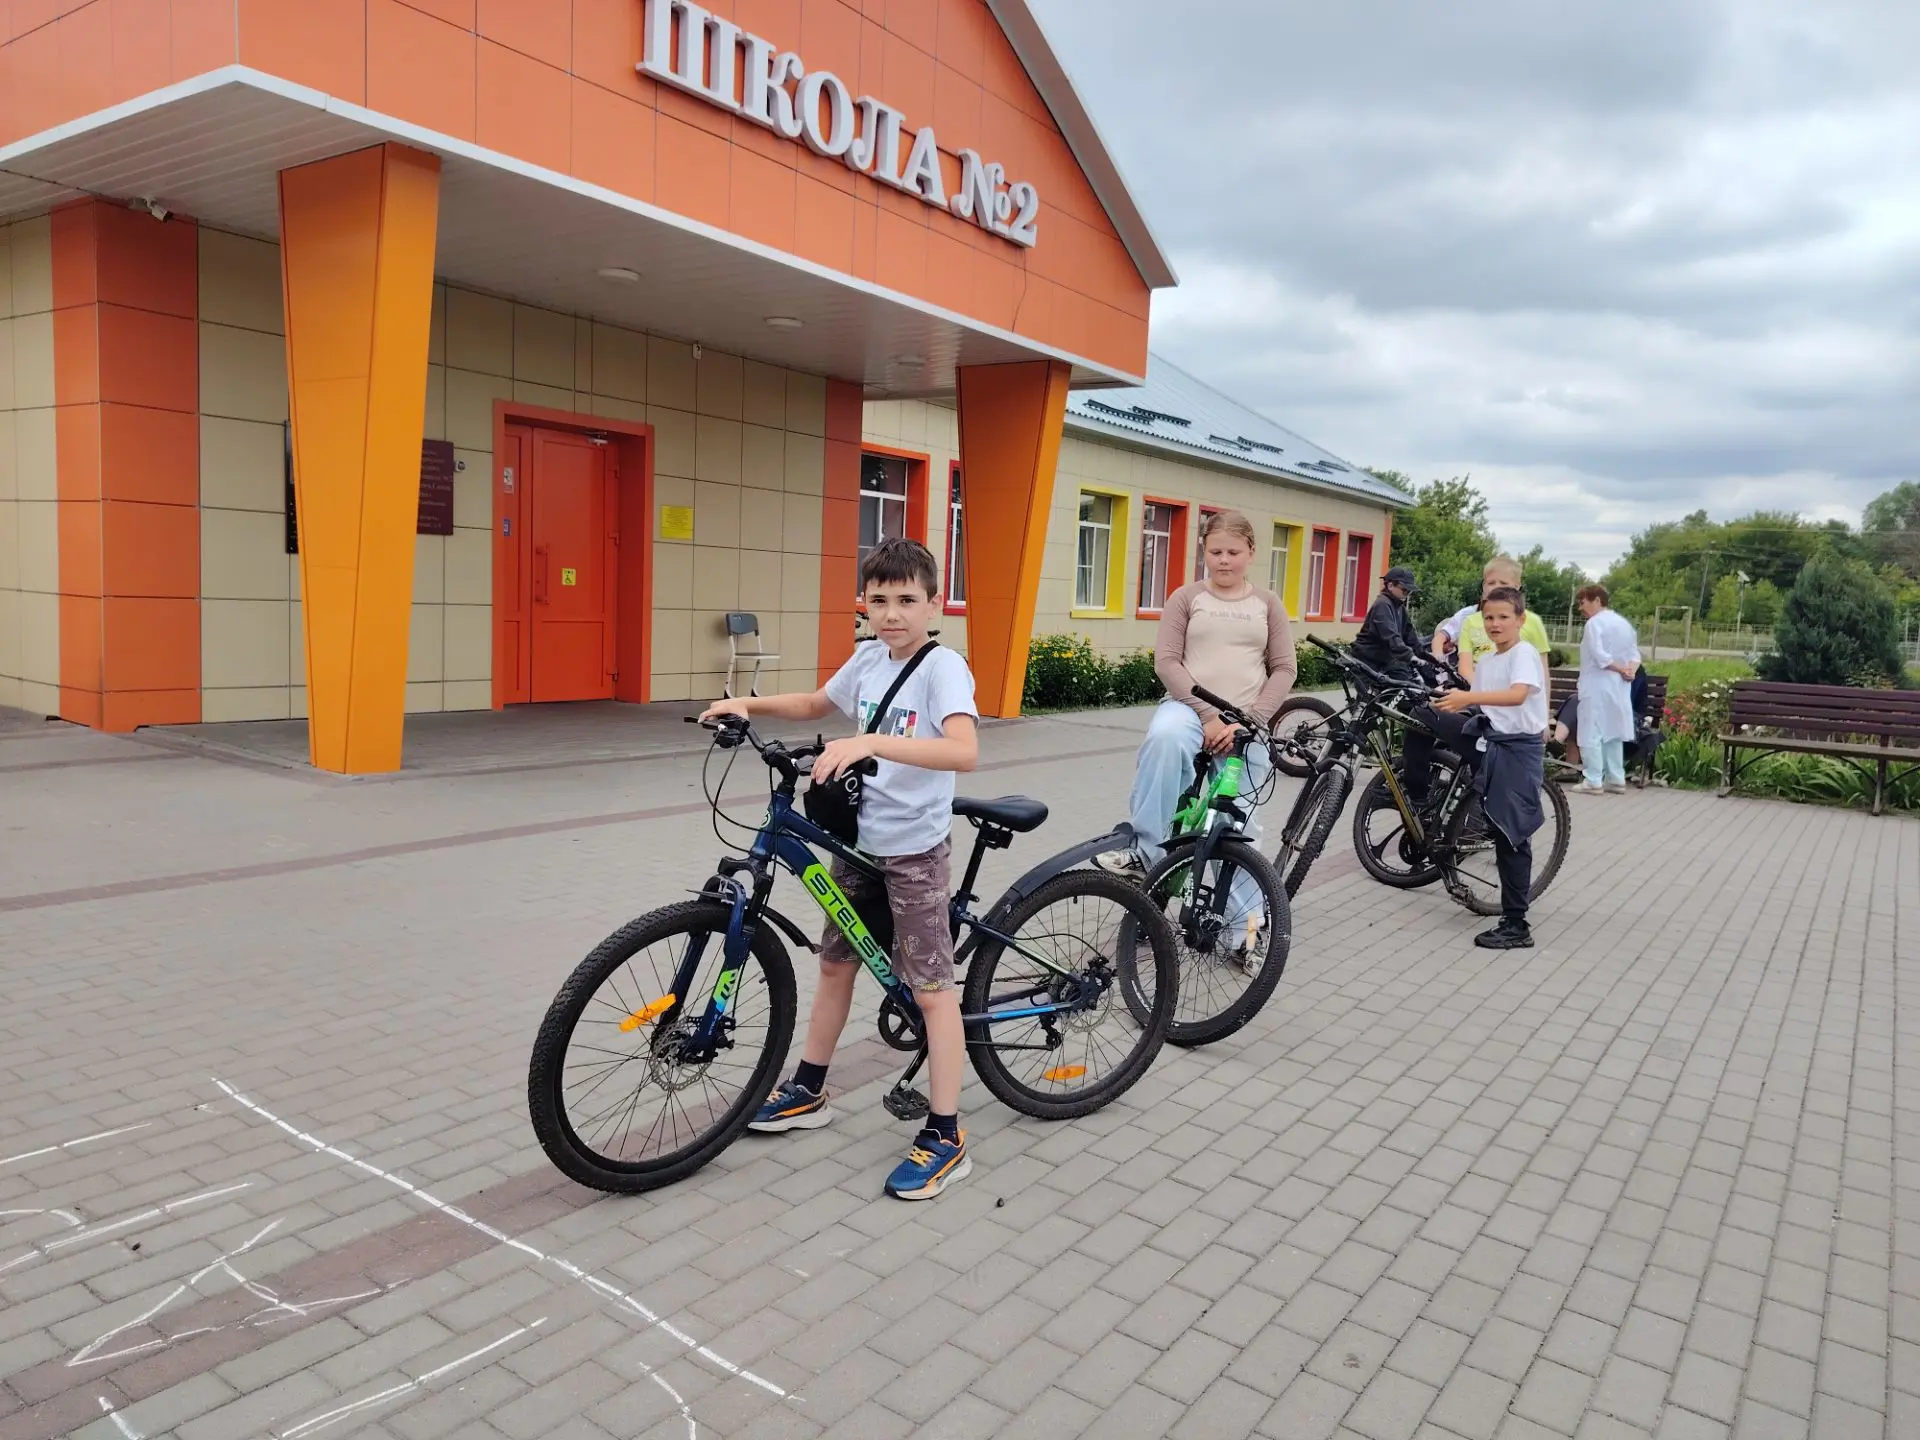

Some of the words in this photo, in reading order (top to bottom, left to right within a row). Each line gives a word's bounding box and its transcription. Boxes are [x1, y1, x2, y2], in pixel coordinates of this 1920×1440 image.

[636, 0, 947, 208] ШКОЛА
[950, 148, 1039, 249] №2
[809, 872, 880, 959] STELS
